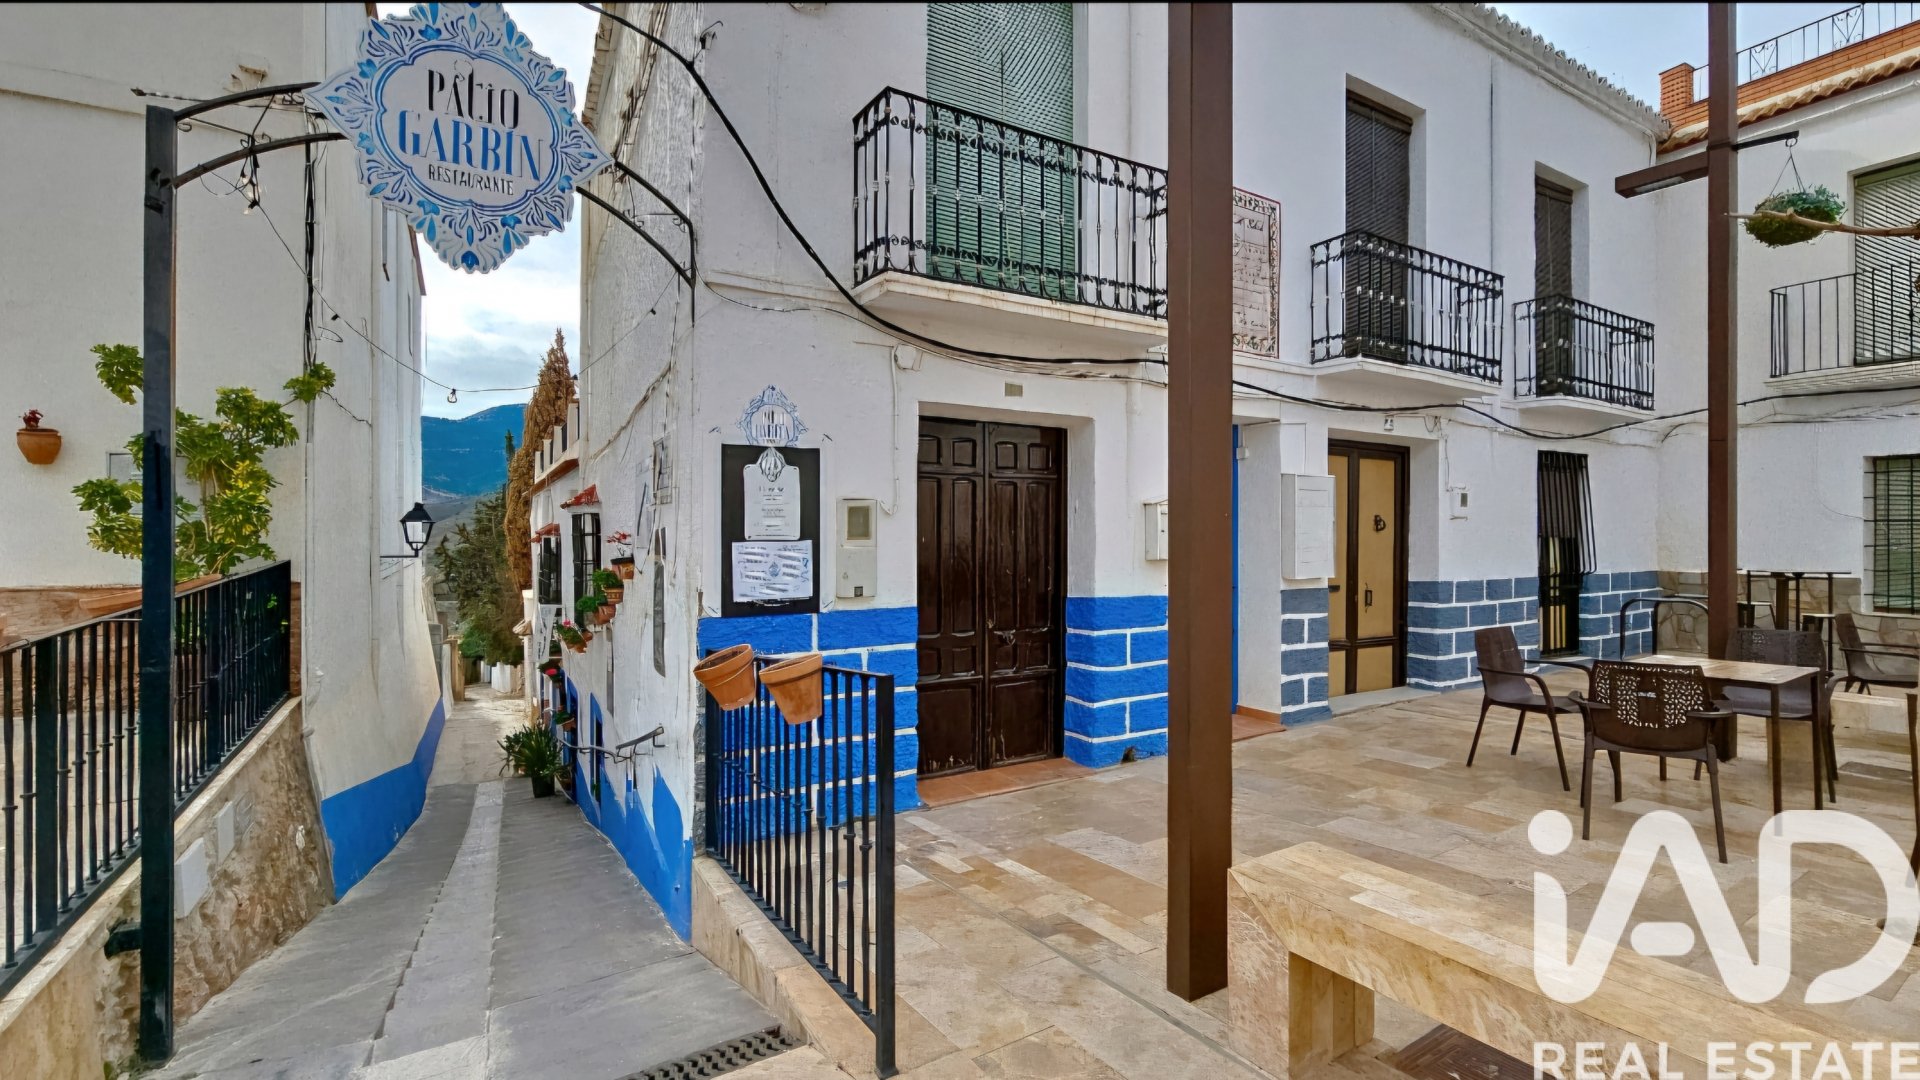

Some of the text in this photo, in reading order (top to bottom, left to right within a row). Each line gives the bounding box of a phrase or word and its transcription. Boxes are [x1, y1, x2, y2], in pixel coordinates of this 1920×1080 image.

[427, 60, 519, 129] PATIO
[399, 110, 543, 182] GARBIN
[428, 164, 514, 195] RESTAURANTE
